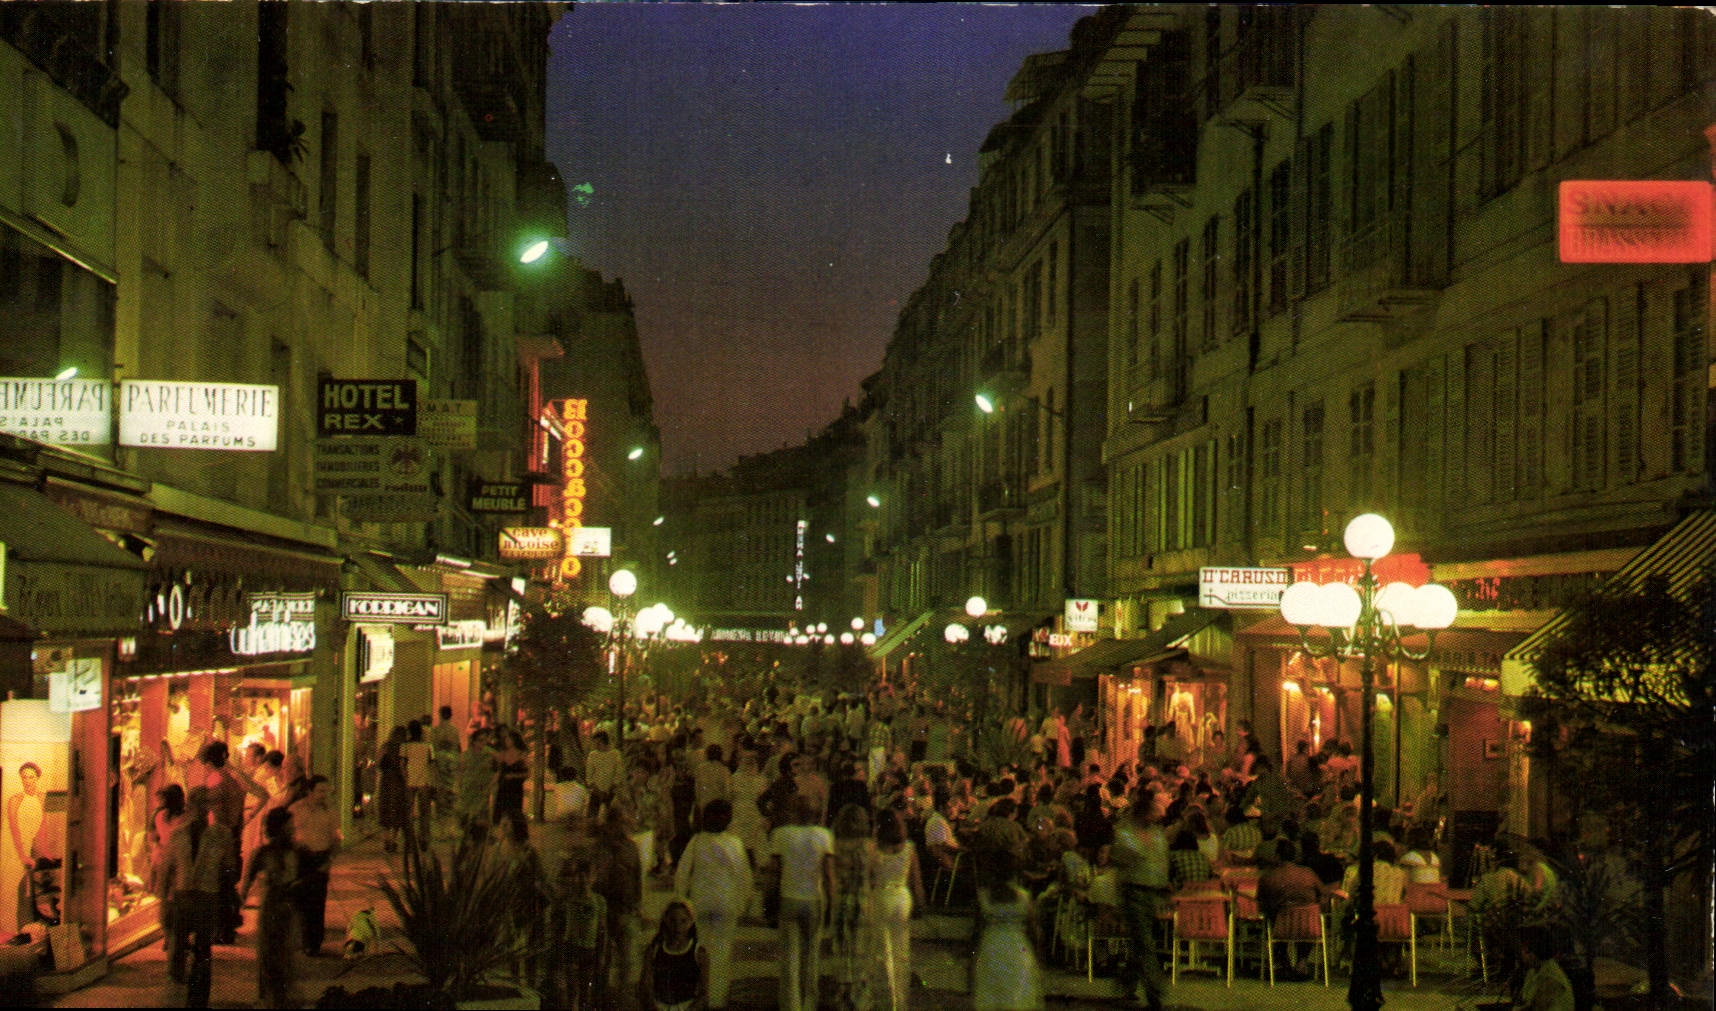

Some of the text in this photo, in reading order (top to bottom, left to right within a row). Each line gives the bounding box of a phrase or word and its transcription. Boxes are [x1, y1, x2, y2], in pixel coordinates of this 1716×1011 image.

[128, 385, 273, 417] PARFUMERIE
[324, 384, 410, 410] HOTEL
[167, 420, 230, 432] PALAIS
[324, 413, 385, 430] REX
[140, 433, 256, 447] DES PARFUMS
[481, 485, 519, 496] PETIT
[1227, 588, 1278, 601] pizzeria
[350, 600, 438, 615] KORRIGAN
